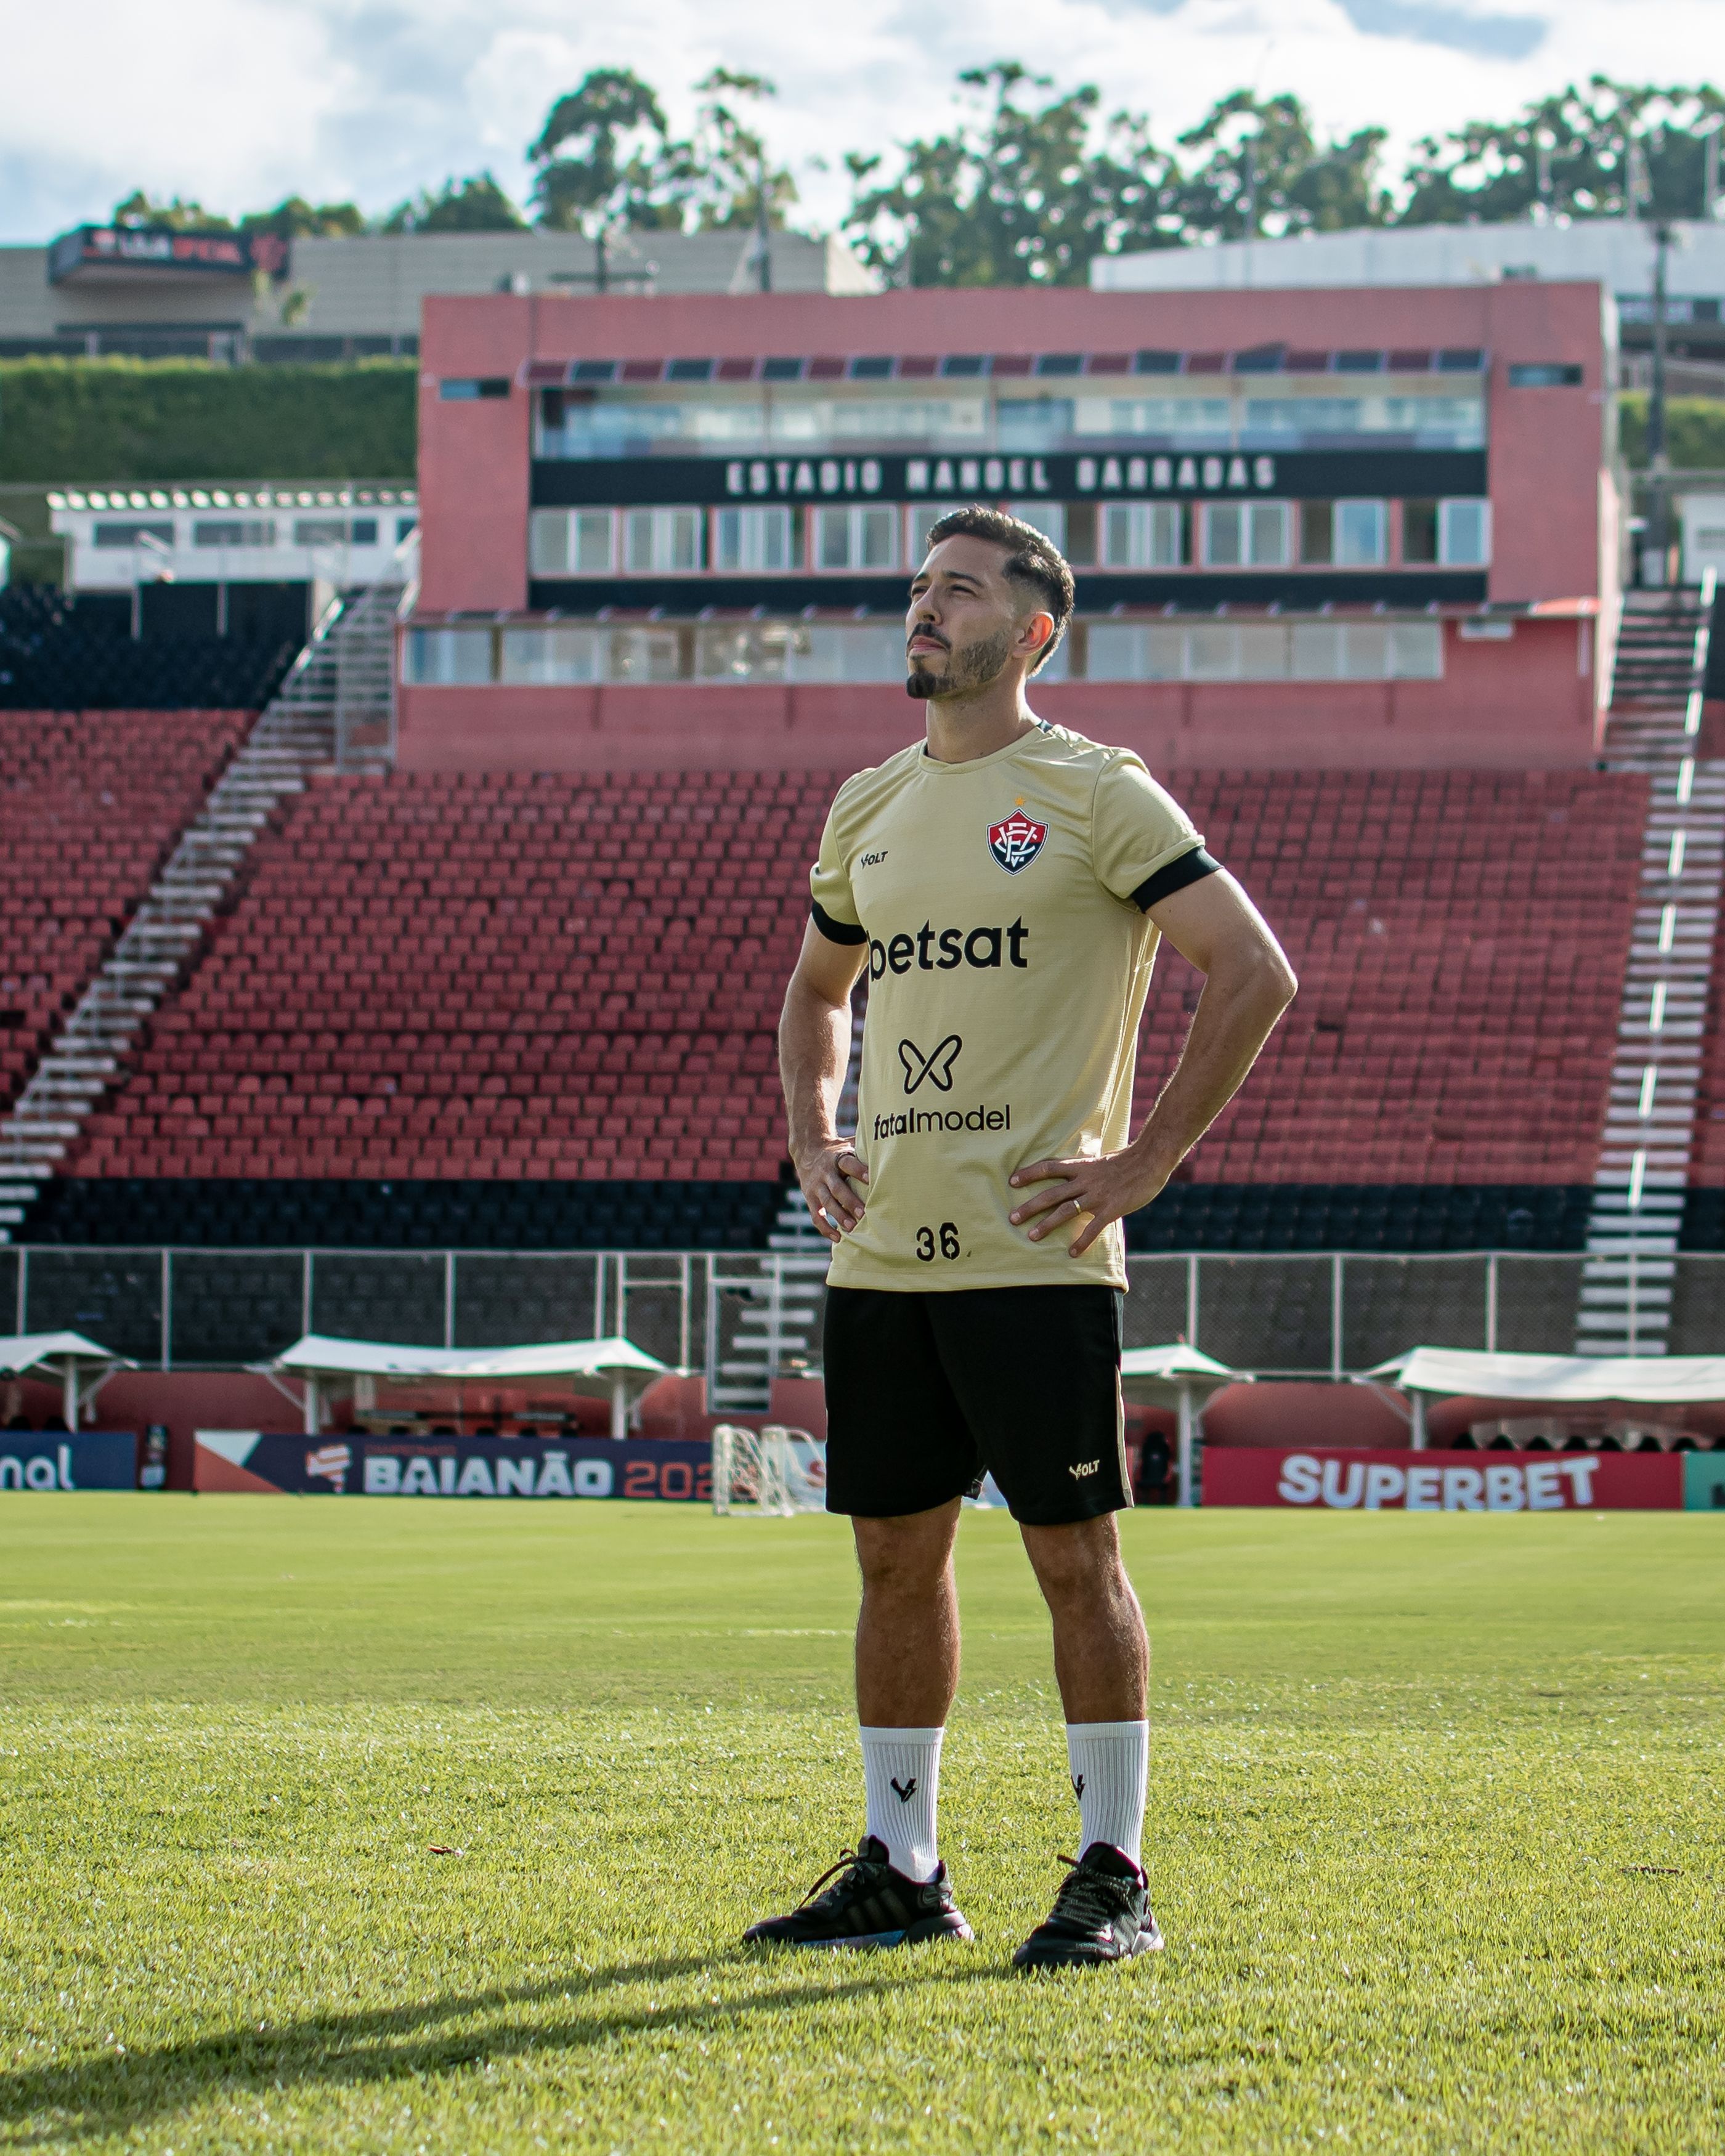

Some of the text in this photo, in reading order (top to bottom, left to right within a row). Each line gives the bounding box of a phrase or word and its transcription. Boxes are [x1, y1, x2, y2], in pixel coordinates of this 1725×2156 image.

[861, 850, 888, 869] VOLT
[866, 915, 1029, 981] betsat
[874, 1104, 1011, 1141] fatalmodel
[916, 1222, 960, 1262] 36
[363, 1452, 612, 1496] BAIANÃO
[1069, 1459, 1100, 1480] VOLT
[1277, 1454, 1600, 1512] SUPERBET
